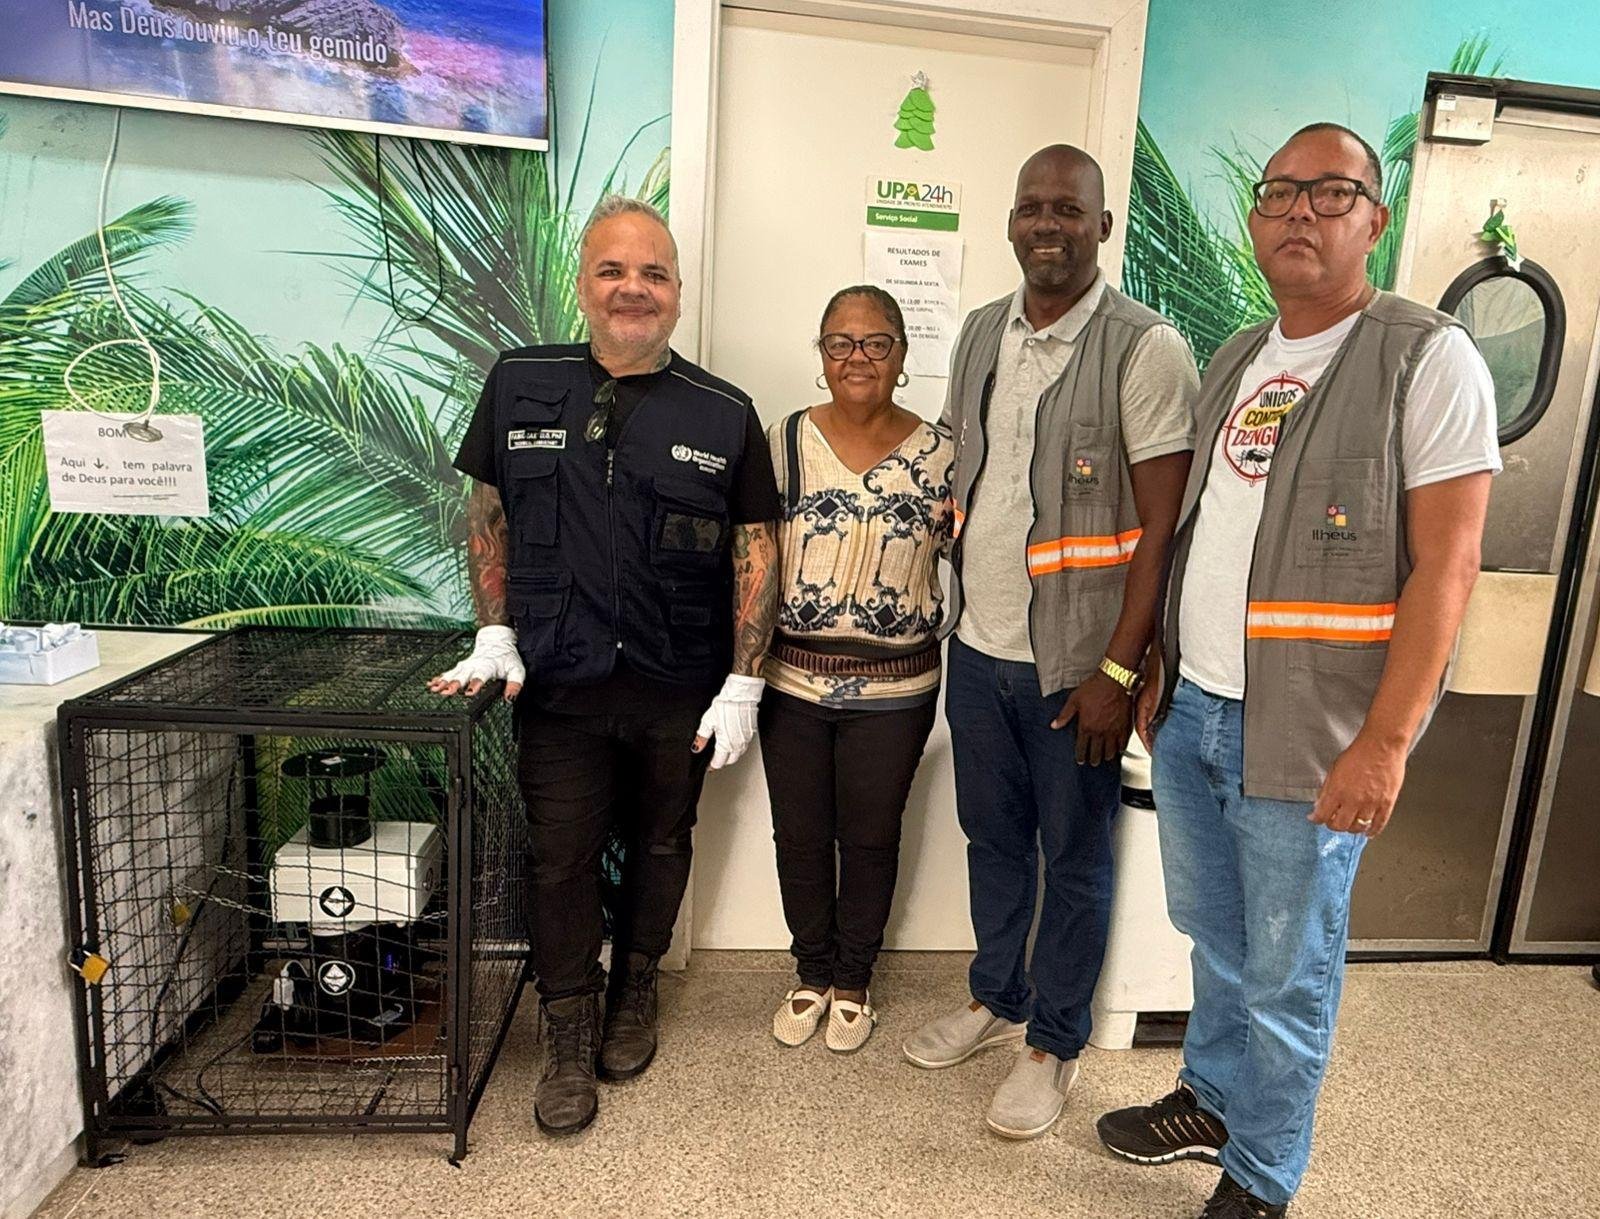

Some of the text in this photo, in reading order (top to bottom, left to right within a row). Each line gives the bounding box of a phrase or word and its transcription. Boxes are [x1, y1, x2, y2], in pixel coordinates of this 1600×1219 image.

[68, 0, 388, 64] Mas Deus ouviu o teu gemido
[875, 213, 918, 223] Serviço Social
[887, 247, 940, 258] RESULTADOS DE
[899, 259, 928, 267] EXAMES
[1259, 387, 1300, 408] UNIDOS
[98, 427, 128, 439] BOM
[60, 457, 193, 473] Aqui tem palavra
[710, 453, 727, 465] Health
[61, 472, 177, 488] de Deus para você!!!
